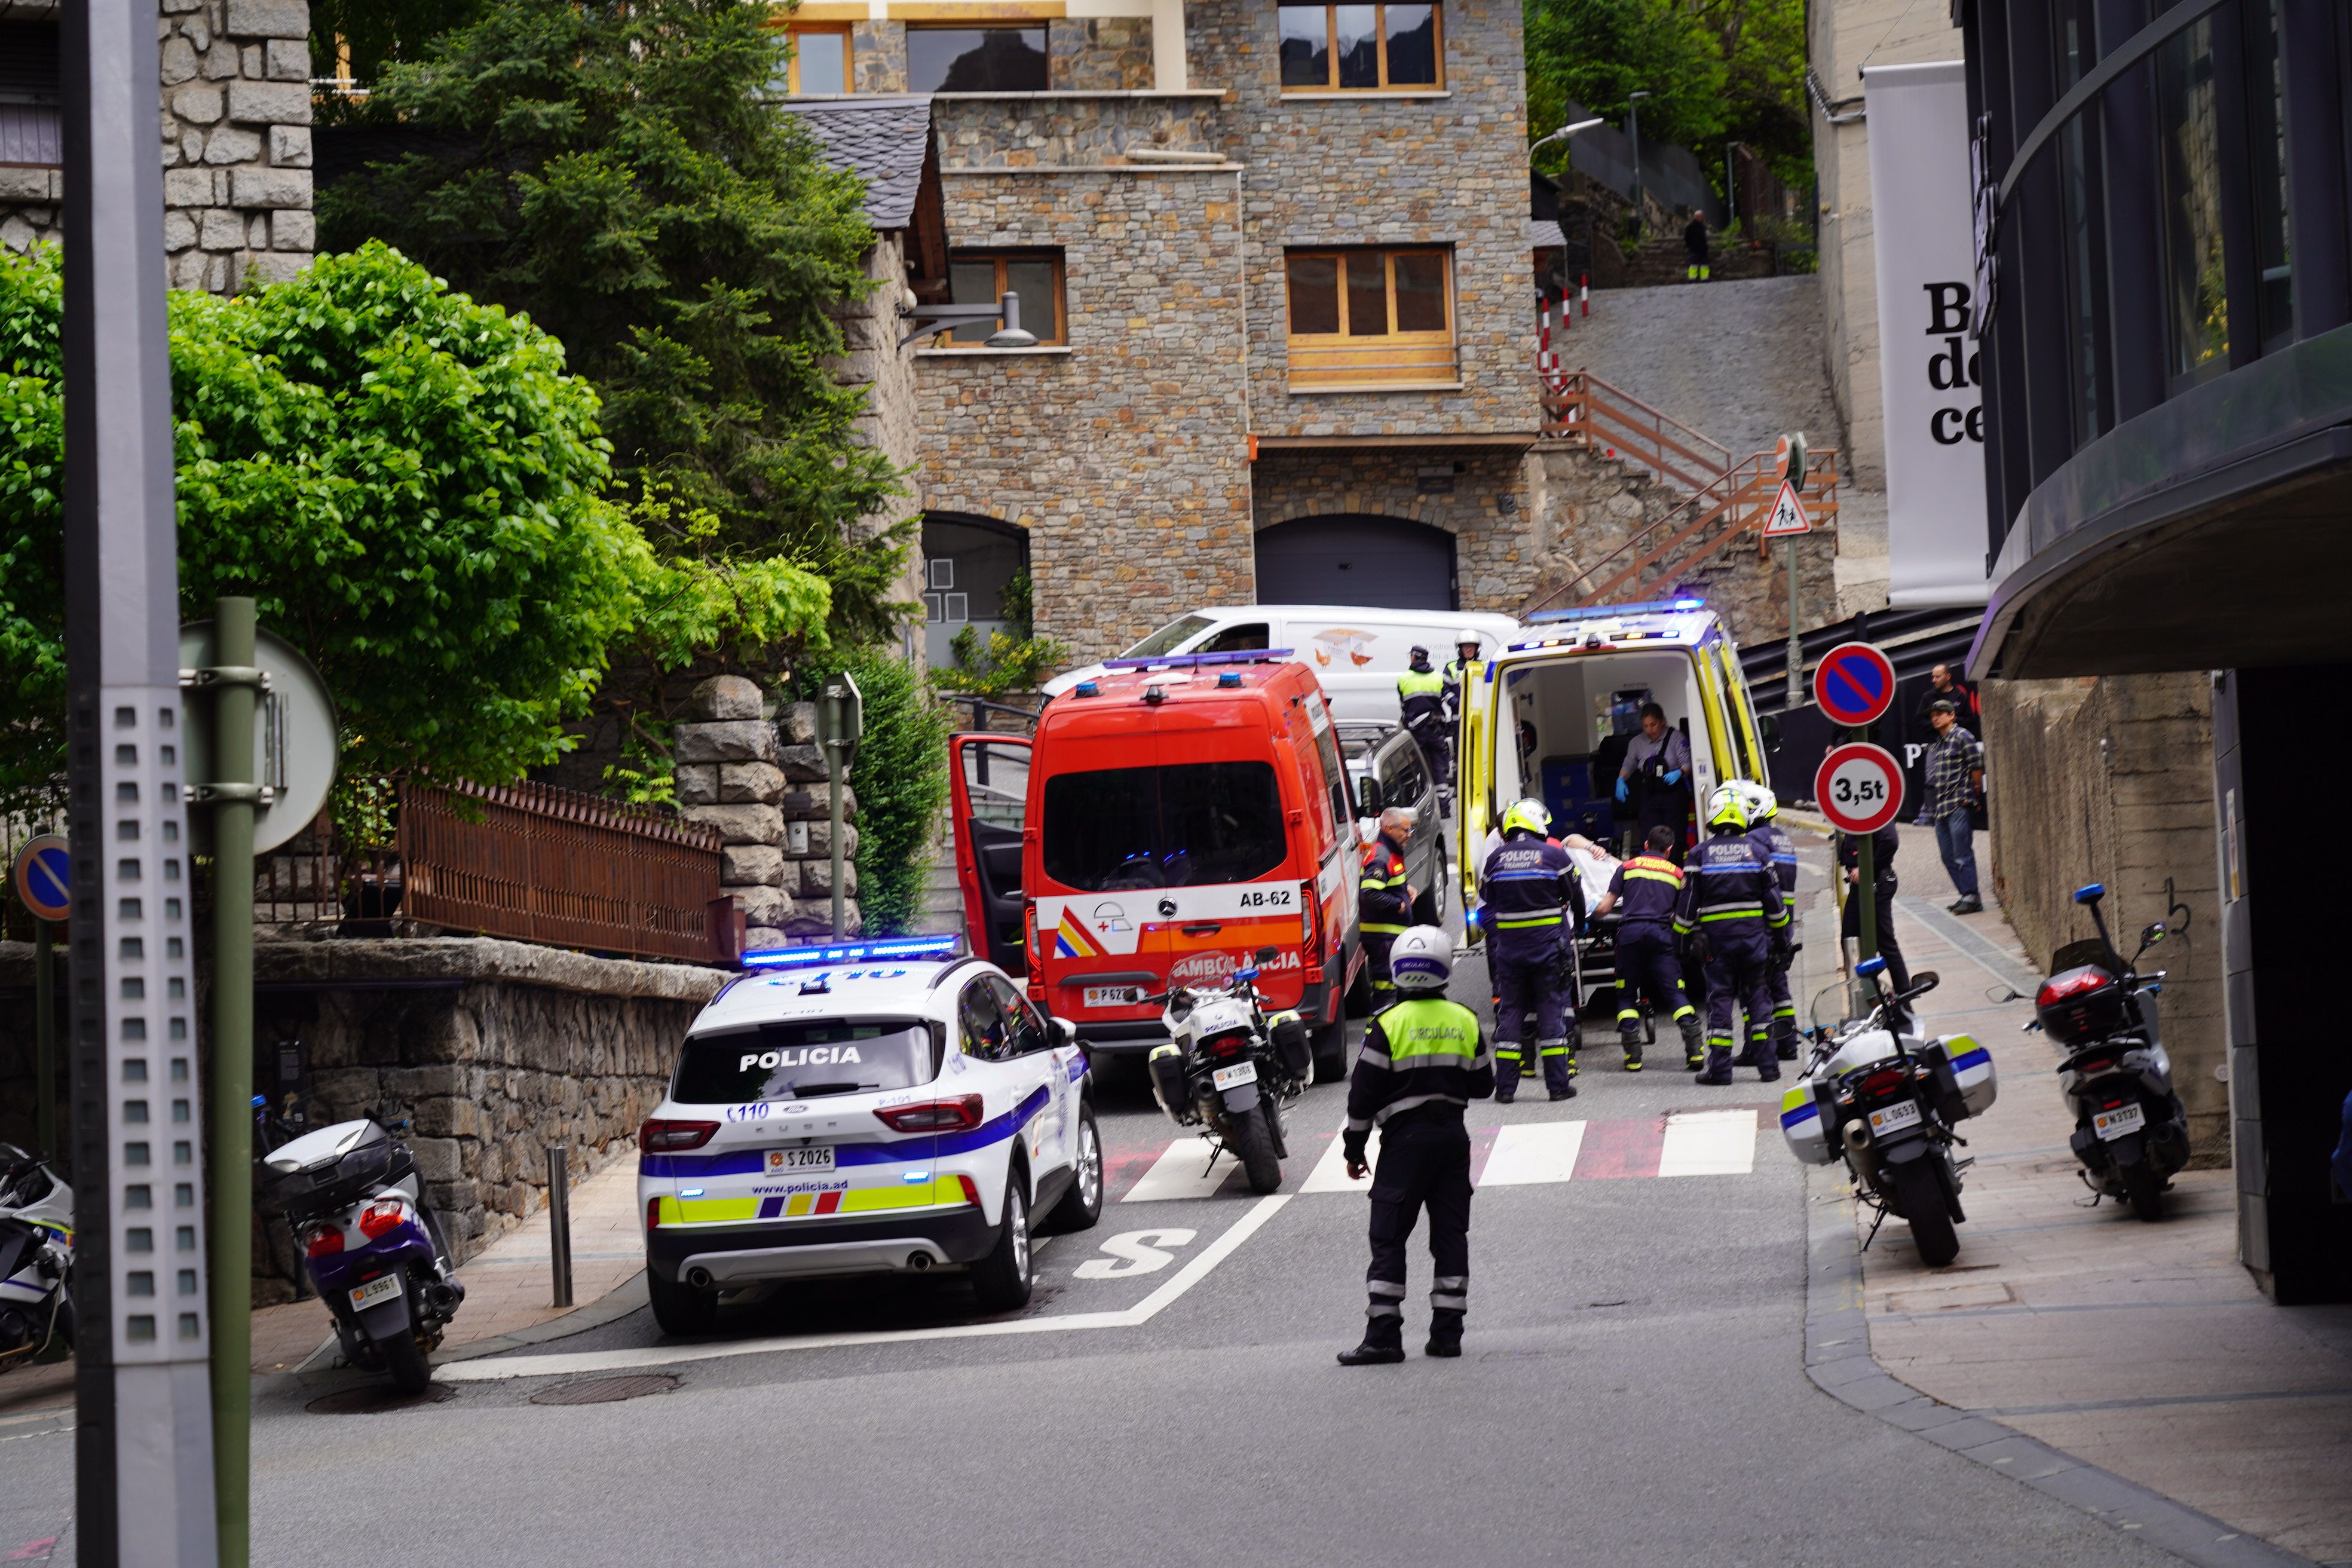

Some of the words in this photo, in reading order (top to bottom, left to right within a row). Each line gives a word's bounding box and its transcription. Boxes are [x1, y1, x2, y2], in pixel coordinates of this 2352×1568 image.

[1836, 778, 1884, 806] 3,5t
[1499, 850, 1542, 864] POLICIA
[1708, 843, 1751, 856] POLICIA
[1240, 891, 1290, 907] AB-62
[739, 1046, 862, 1073] POLICIA
[737, 1102, 769, 1121] 110
[798, 1149, 831, 1165] 2026
[752, 1179, 849, 1195] www.policia.ad
